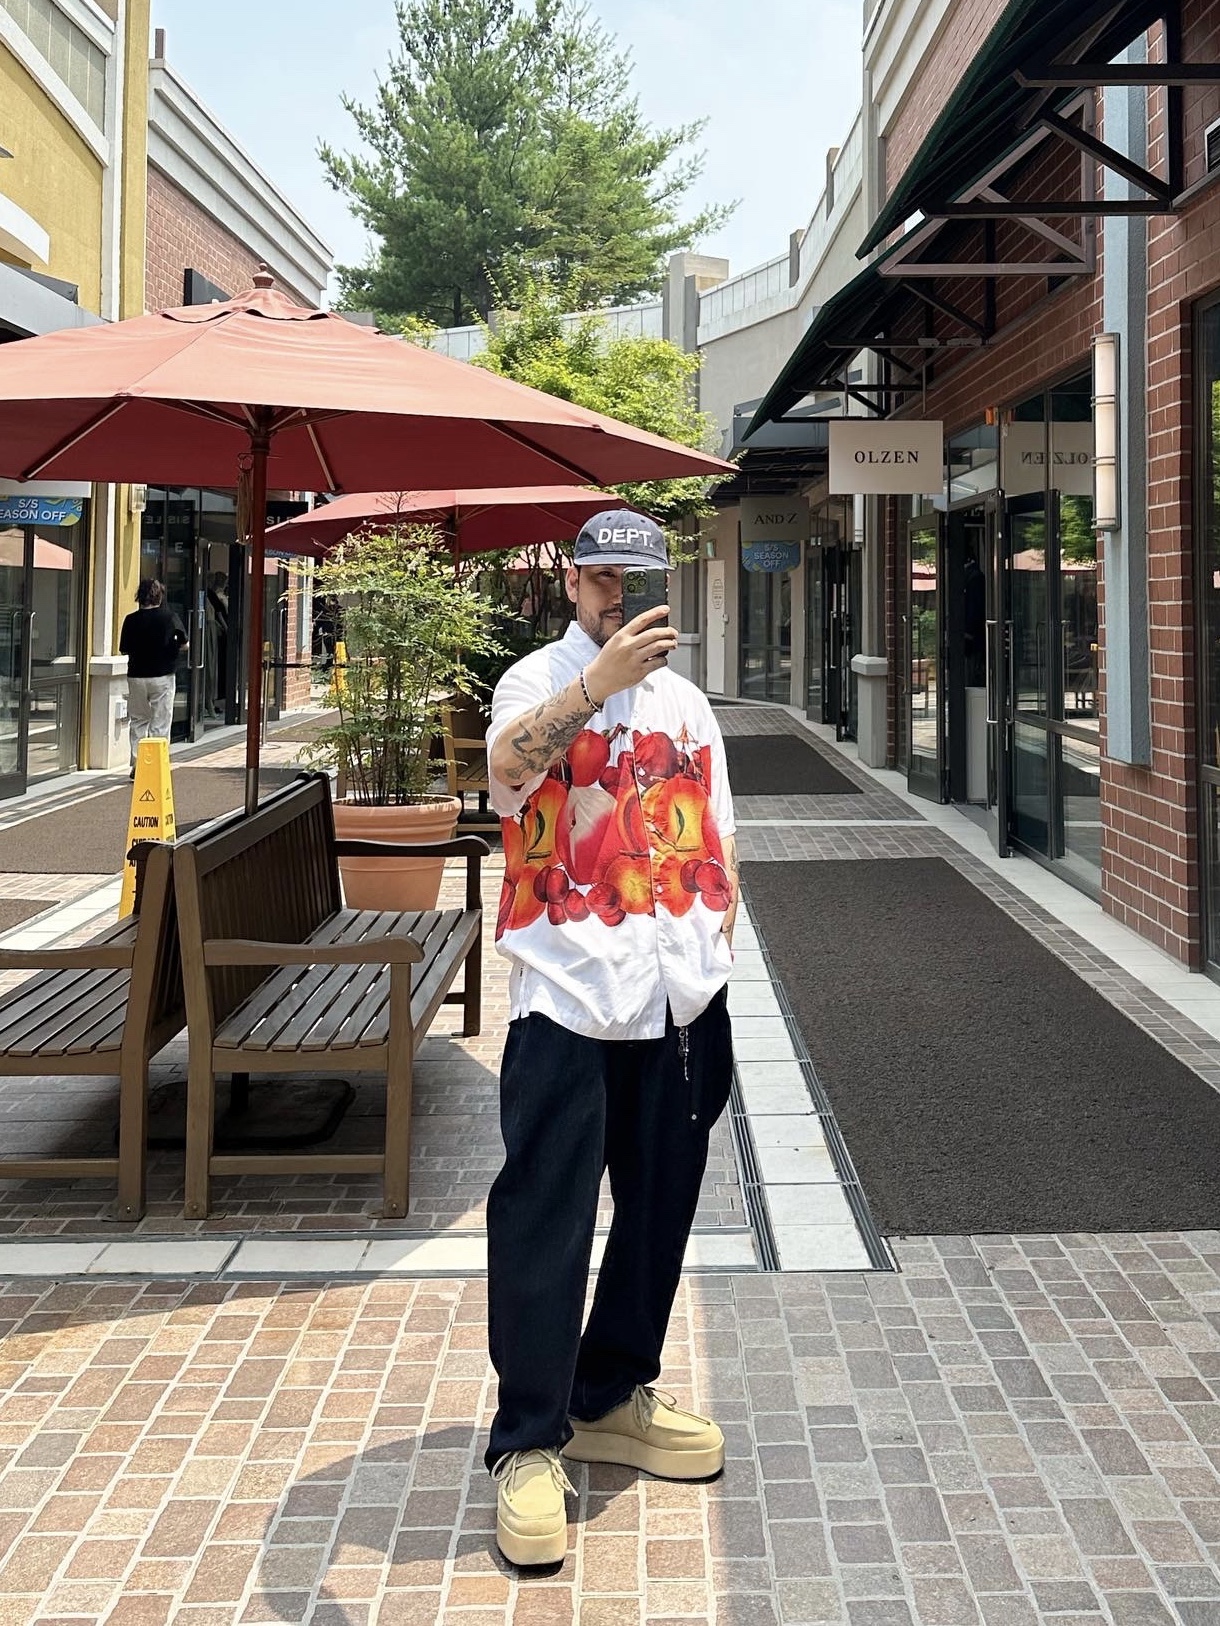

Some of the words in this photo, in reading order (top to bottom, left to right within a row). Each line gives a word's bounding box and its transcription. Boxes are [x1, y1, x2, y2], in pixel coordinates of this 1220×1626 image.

[854, 450, 919, 464] OLZEN
[18, 498, 39, 509] S/S
[0, 509, 38, 519] EASON
[41, 510, 67, 521] OFF
[754, 514, 785, 525] AND
[787, 512, 798, 524] Z
[597, 528, 654, 548] DEPT.
[753, 552, 789, 560] SEASON
[763, 560, 781, 569] OFF
[133, 816, 159, 828] CAUTION
